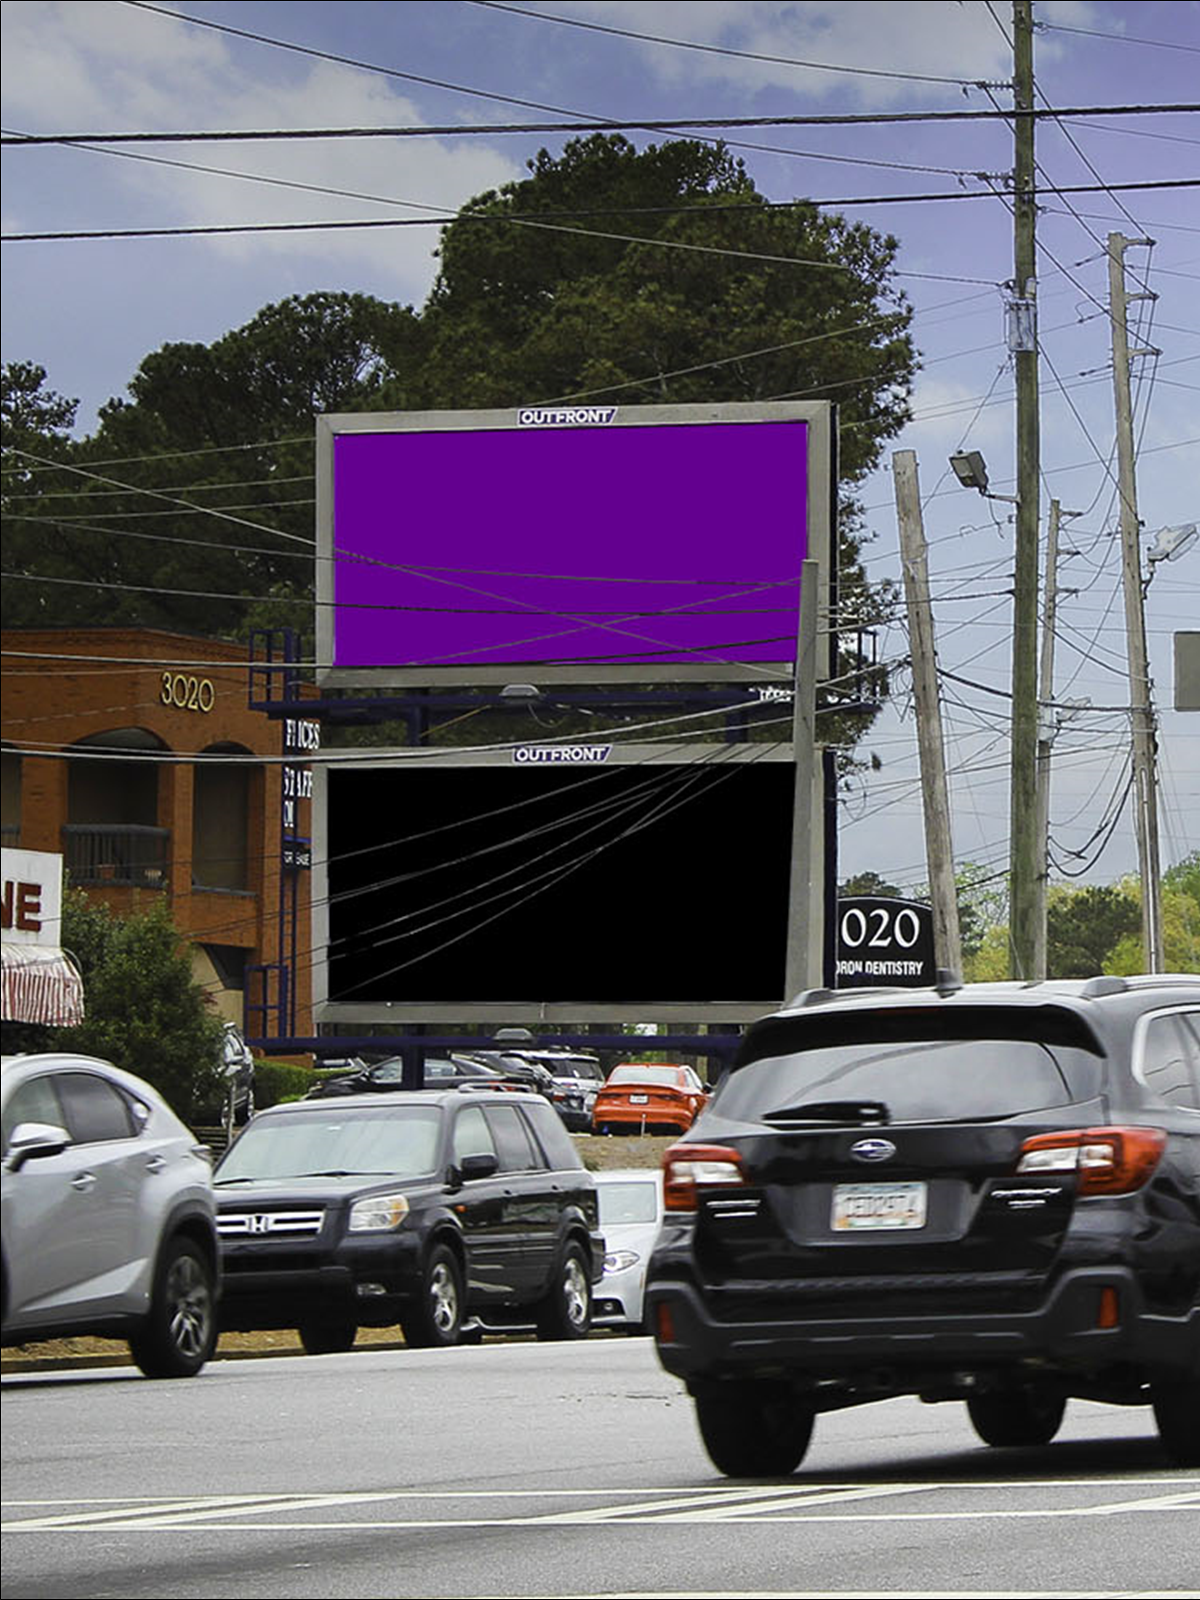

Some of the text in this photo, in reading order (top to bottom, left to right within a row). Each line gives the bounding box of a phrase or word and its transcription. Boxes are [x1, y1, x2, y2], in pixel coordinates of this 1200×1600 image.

[521, 409, 612, 424] OUTFRONT
[161, 671, 215, 712] 3020
[516, 747, 606, 761] OUTFRONT
[841, 908, 920, 948] 020
[865, 961, 924, 976] DENTISTRY
